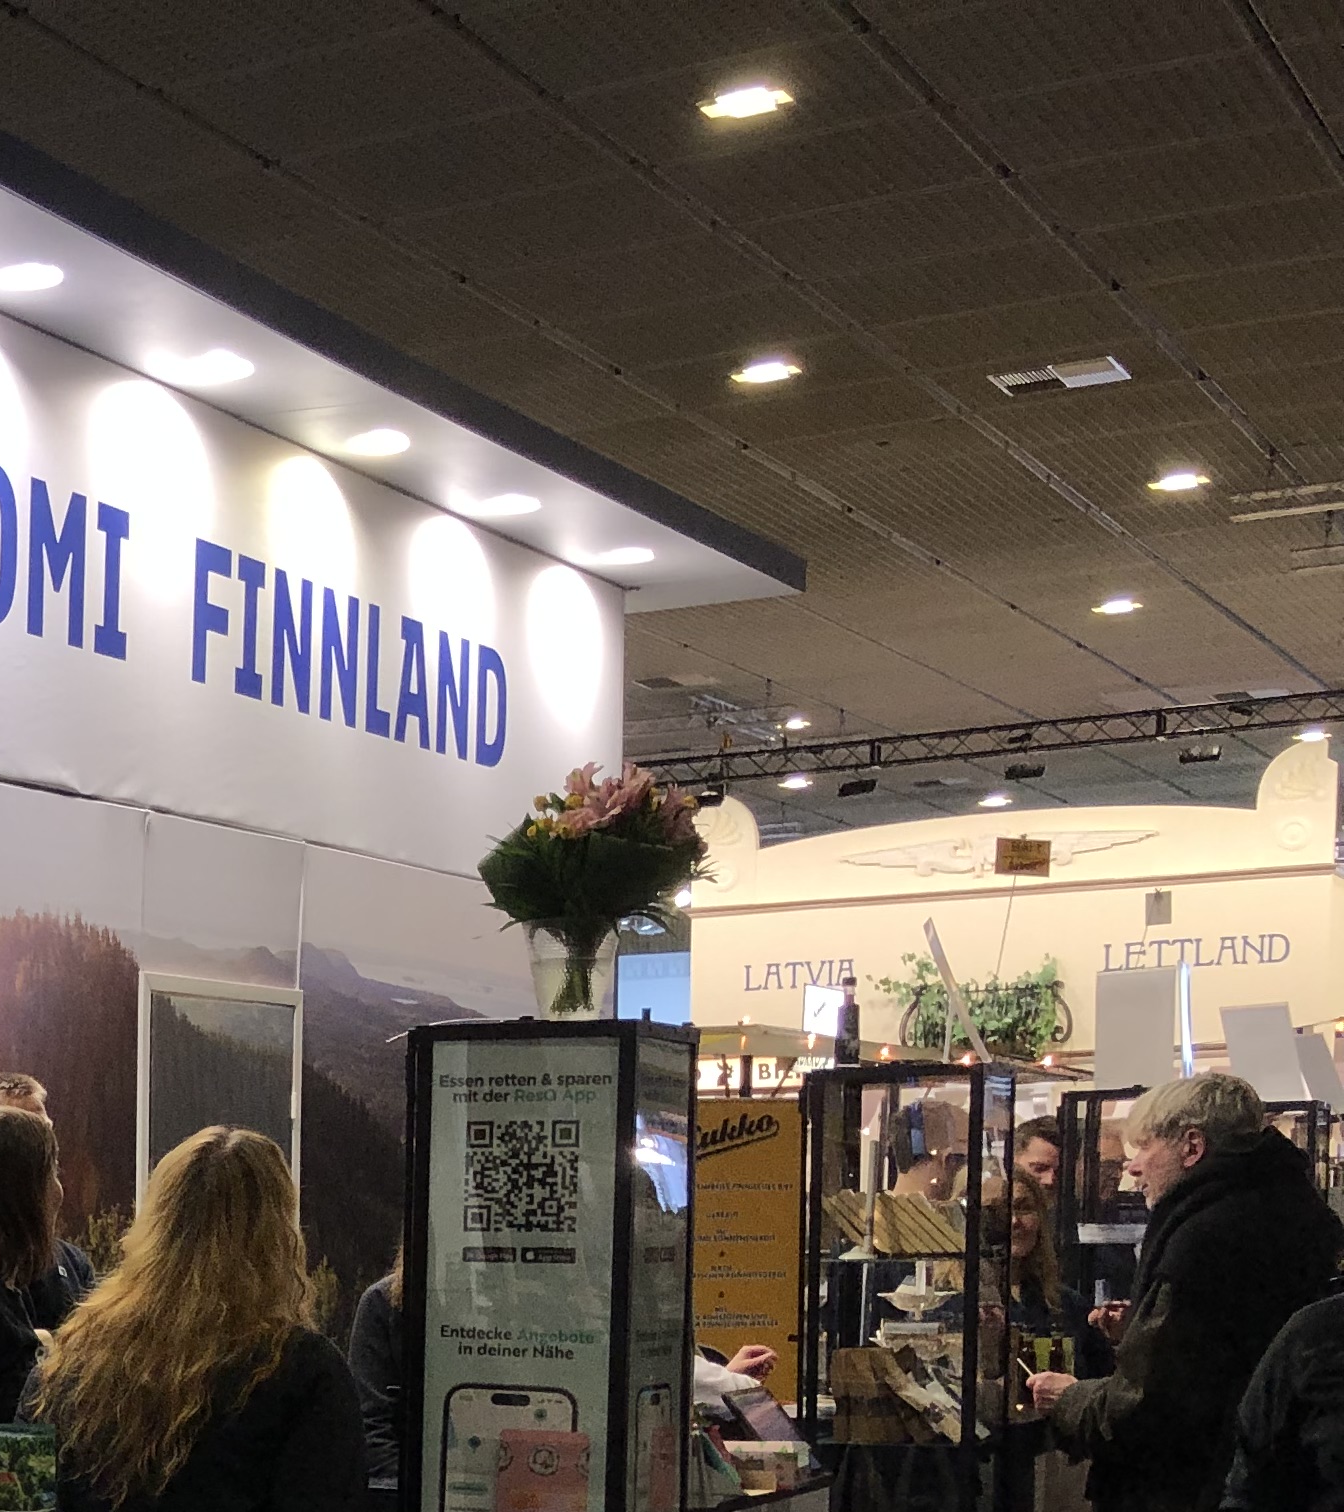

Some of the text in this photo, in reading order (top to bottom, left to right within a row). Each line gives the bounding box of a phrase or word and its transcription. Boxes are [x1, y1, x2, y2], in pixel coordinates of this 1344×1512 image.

[191, 537, 508, 768] FINNLAND
[744, 933, 1291, 992] LATVIA LETTLAND
[439, 1073, 613, 1088] Essen retten & sparen
[452, 1089, 478, 1103] mit
[483, 1089, 511, 1103] der
[563, 1088, 597, 1106] App
[440, 1324, 595, 1345] Entdecke Angebote
[458, 1341, 574, 1361] in deiner Nähe
